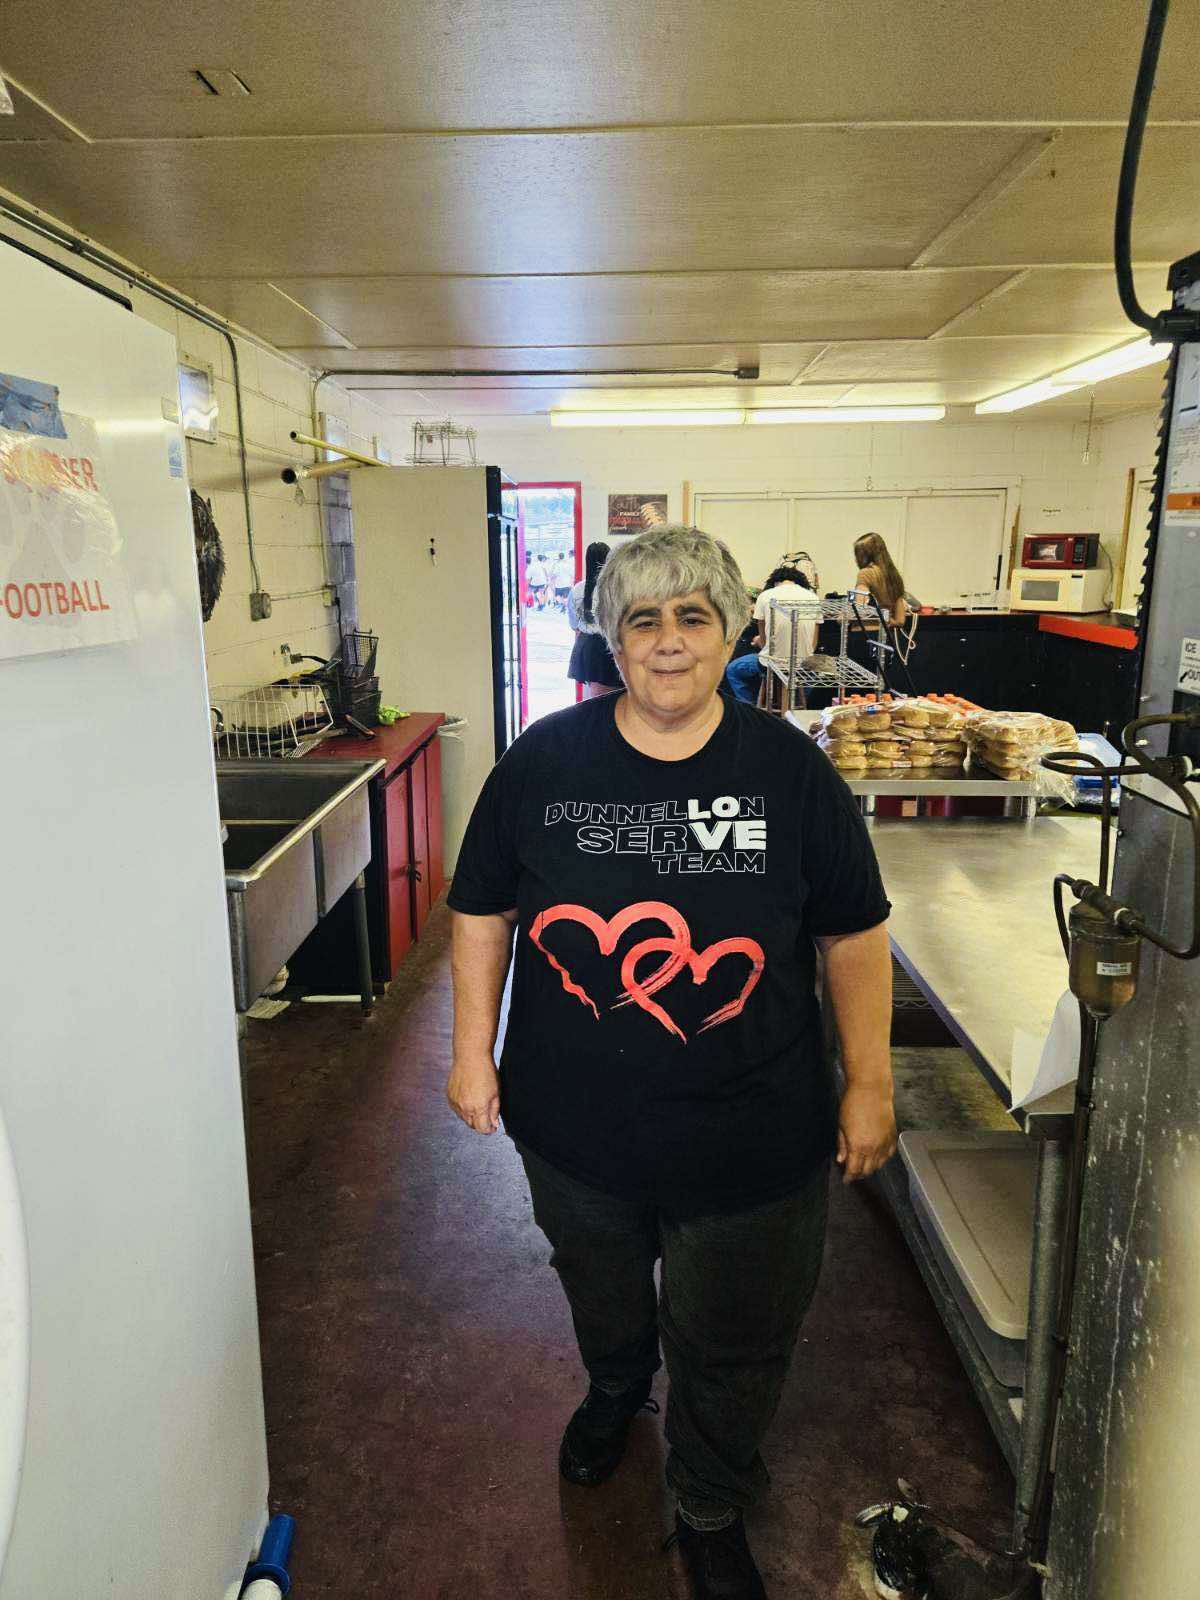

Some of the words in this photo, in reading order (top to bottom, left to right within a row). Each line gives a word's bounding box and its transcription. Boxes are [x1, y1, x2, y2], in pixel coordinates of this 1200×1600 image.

[544, 796, 765, 825] DUNNELLON
[576, 820, 767, 854] SERVE
[652, 852, 766, 874] TEAM
